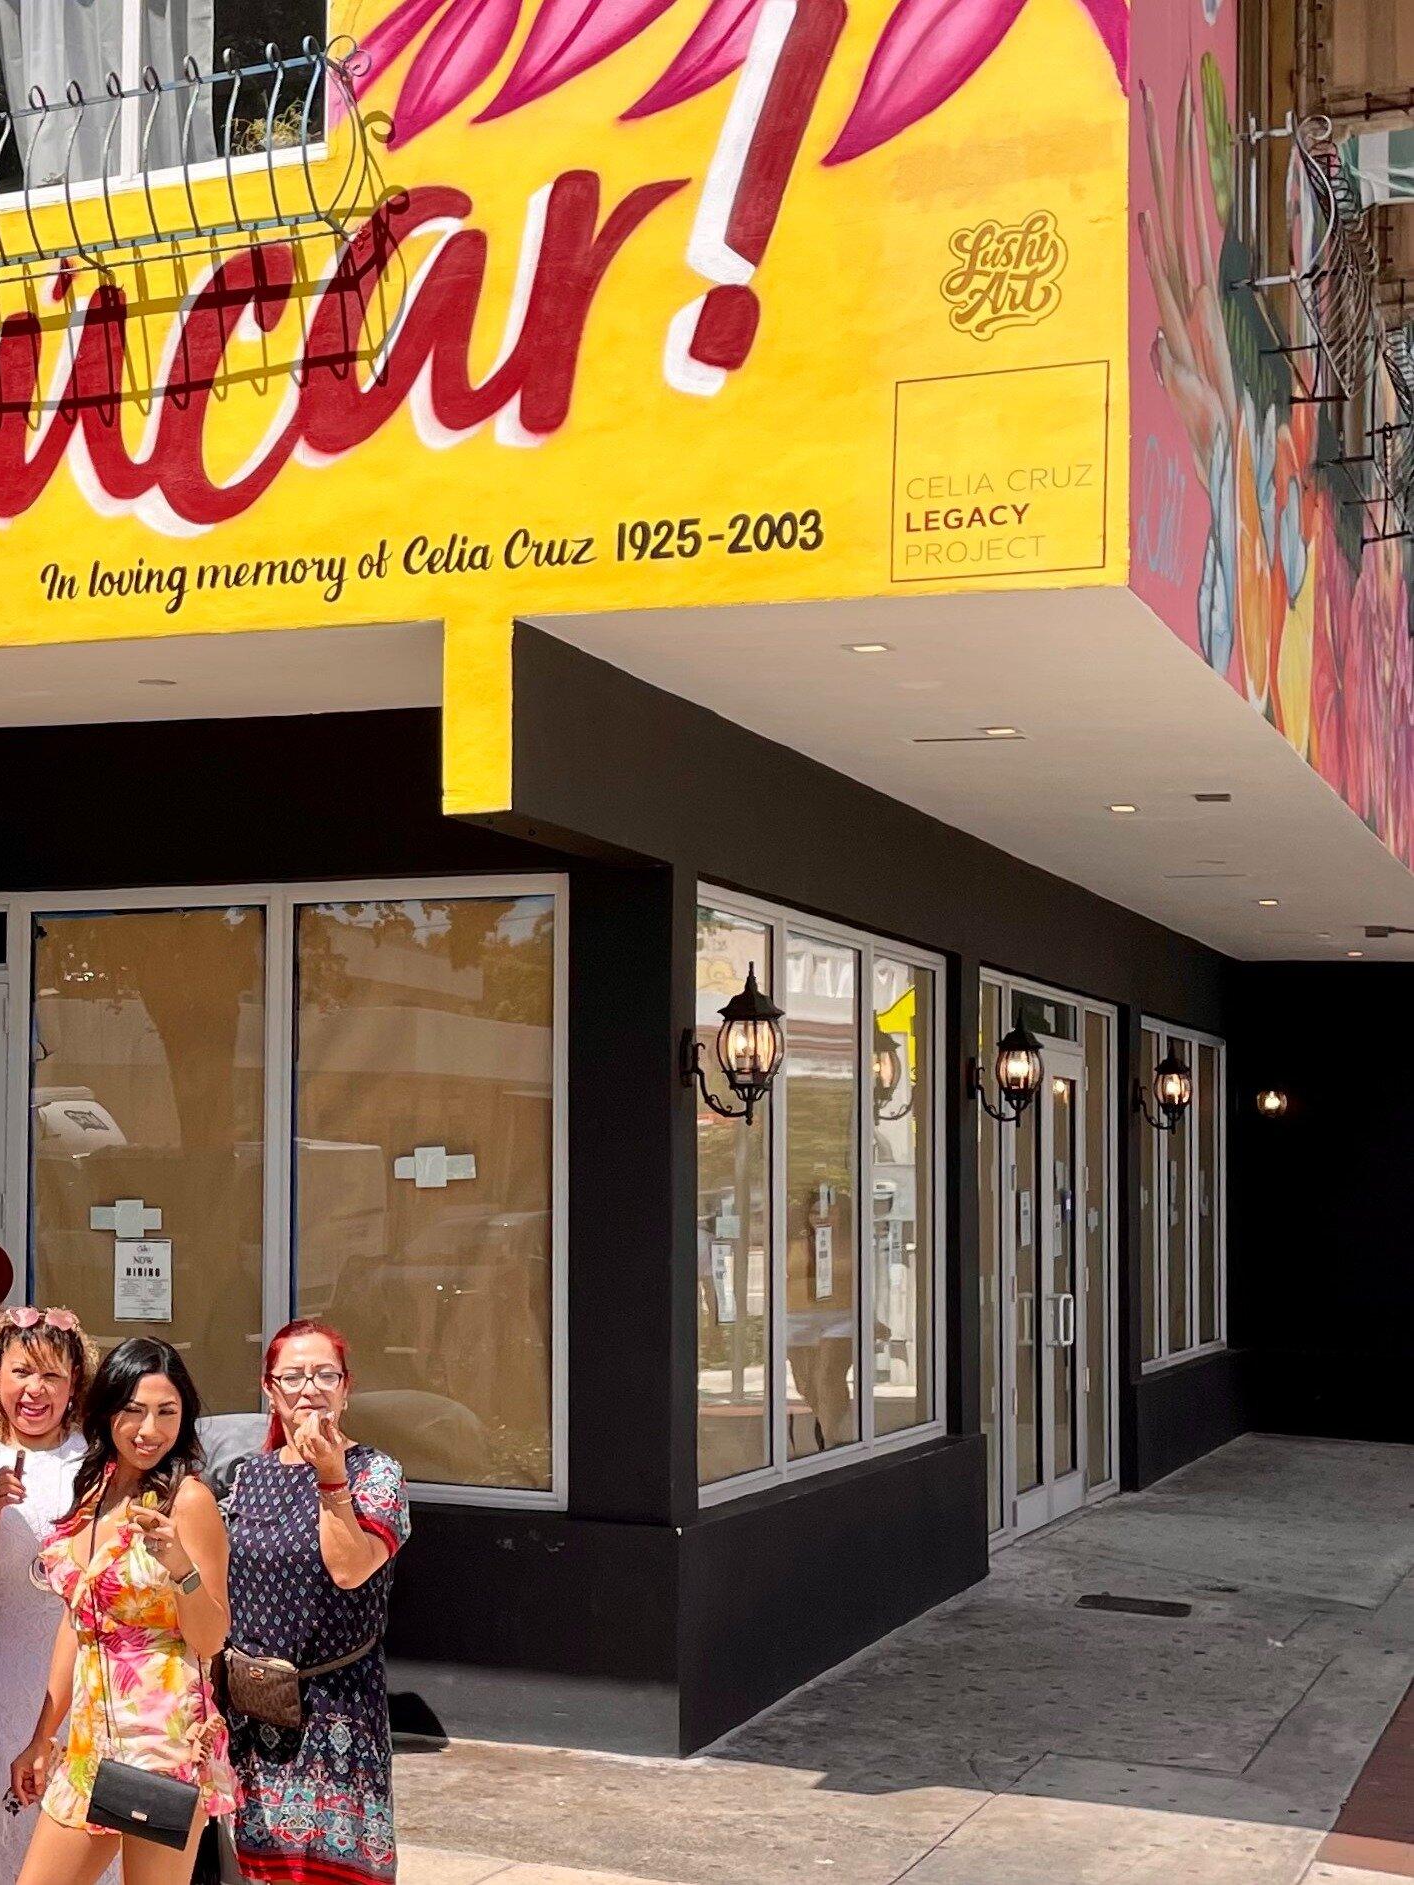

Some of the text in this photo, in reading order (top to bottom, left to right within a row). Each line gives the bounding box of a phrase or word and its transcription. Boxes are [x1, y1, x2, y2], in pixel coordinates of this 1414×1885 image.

[954, 267, 1052, 325] Art
[906, 463, 1093, 500] CELIA CRUZ
[905, 502, 1030, 533] LEGACY
[40, 508, 824, 614] In loving memory of Celia Cruz 1925-2003
[905, 534, 1046, 565] PROJECT
